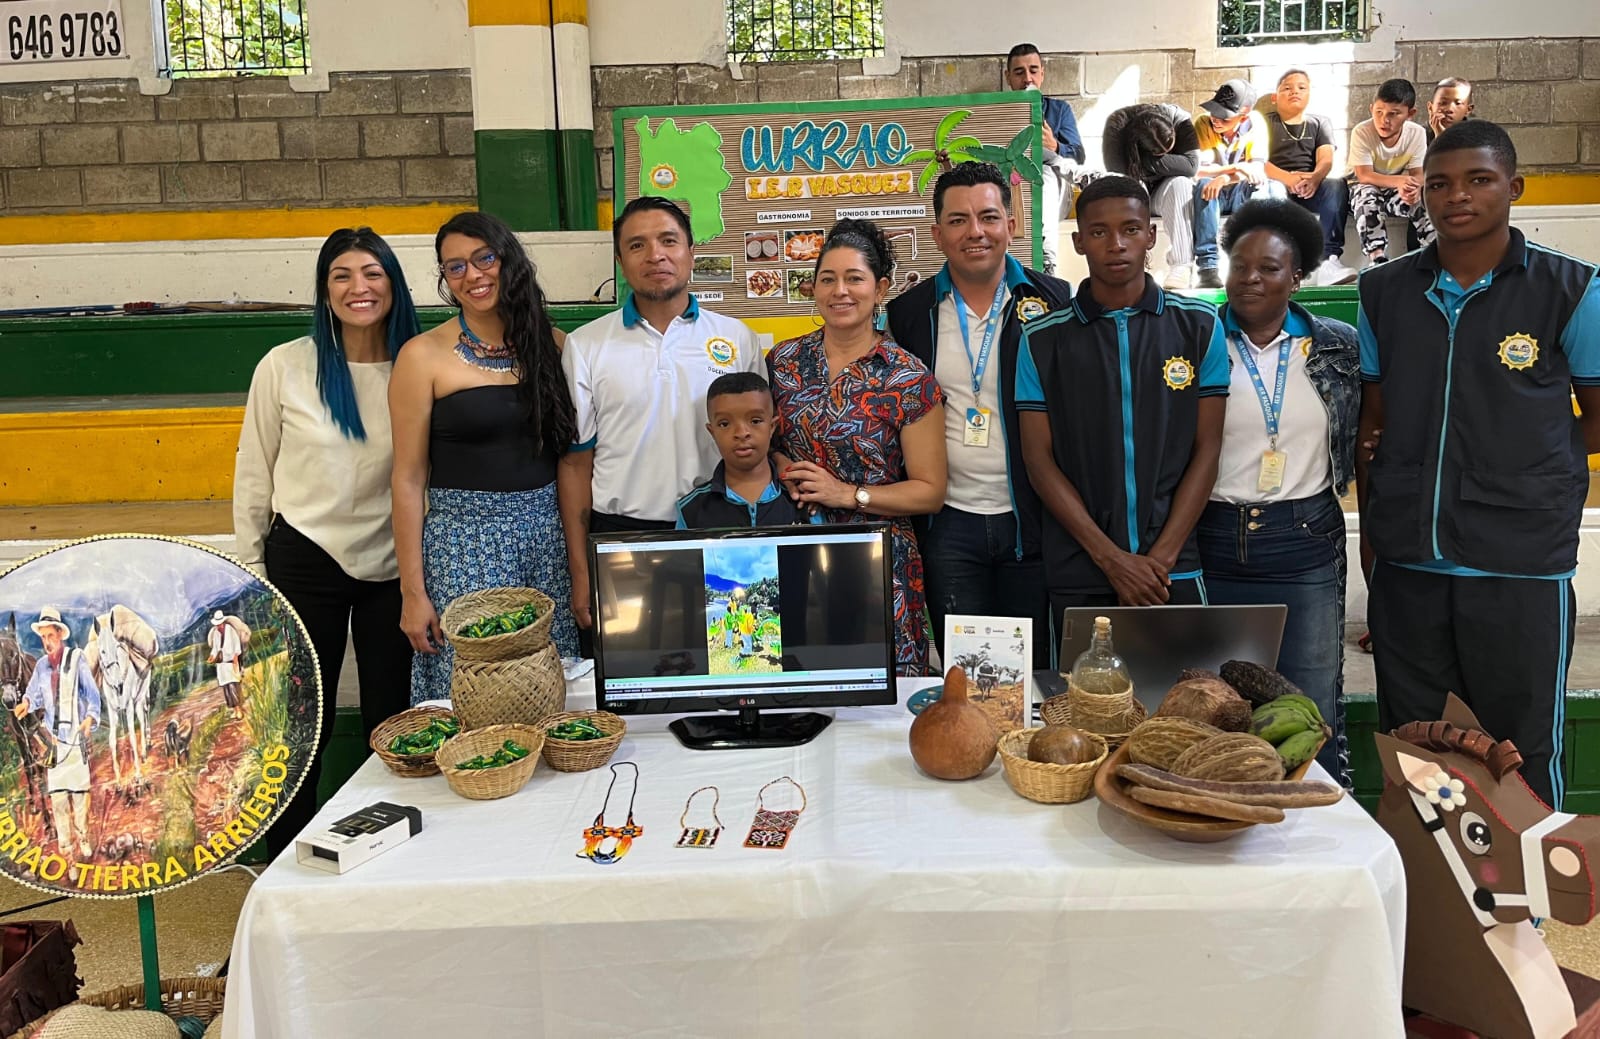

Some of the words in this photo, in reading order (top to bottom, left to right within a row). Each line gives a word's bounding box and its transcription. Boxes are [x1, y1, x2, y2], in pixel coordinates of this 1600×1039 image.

[8, 14, 54, 60] 646
[60, 10, 121, 58] 9783
[740, 119, 914, 173] URRAO
[747, 178, 804, 199] I.E.R
[807, 172, 912, 197] VASQUEZ
[758, 212, 811, 221] GASTRONOMIA
[837, 210, 869, 218] SONIDOS
[870, 209, 880, 217] DE
[881, 208, 925, 217] TERRITORIO
[981, 331, 992, 357] VASQUEZ
[1275, 371, 1284, 394] VASQUEZ
[1262, 395, 1275, 422] VASQUEZ
[75, 855, 187, 891] TIERRA
[193, 744, 290, 872] ARRIEROS
